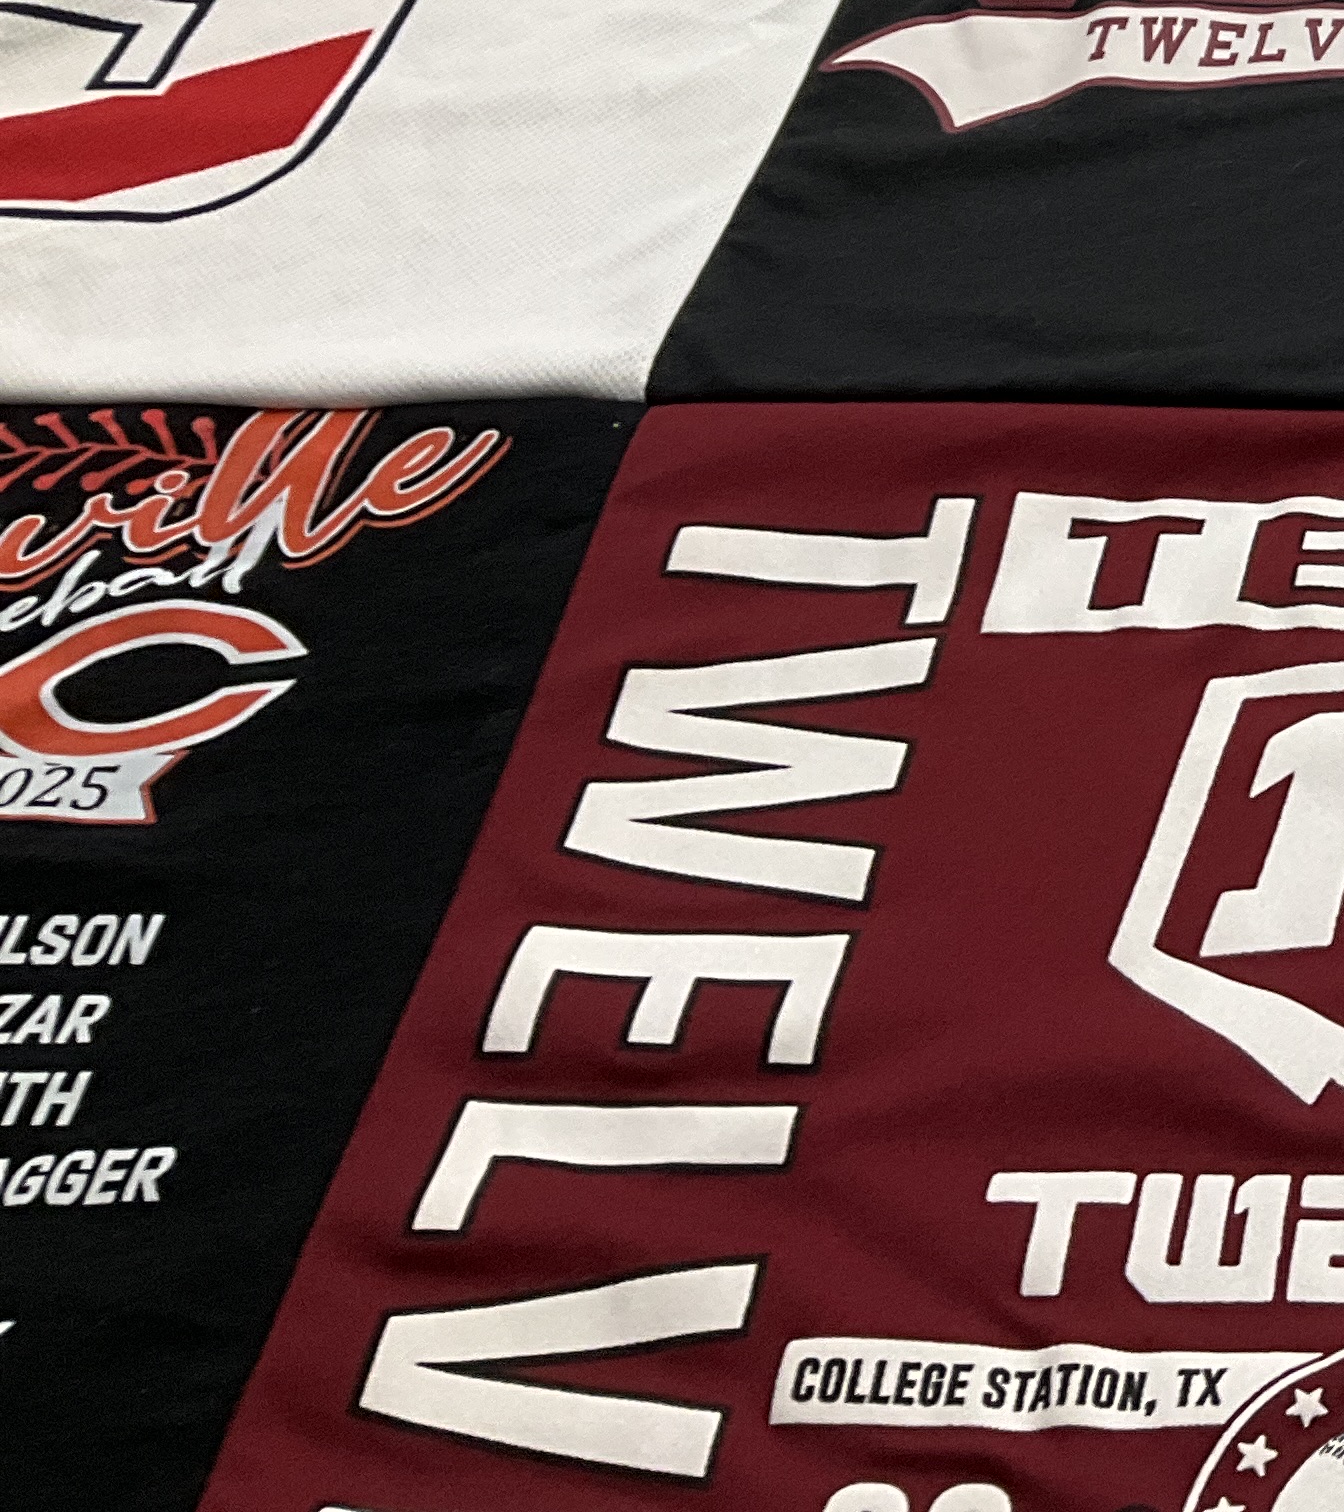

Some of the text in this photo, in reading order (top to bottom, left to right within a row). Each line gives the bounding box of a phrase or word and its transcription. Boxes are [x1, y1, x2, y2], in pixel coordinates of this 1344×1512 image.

[790, 1355, 1227, 1417] COLLEGE STATION, TX
